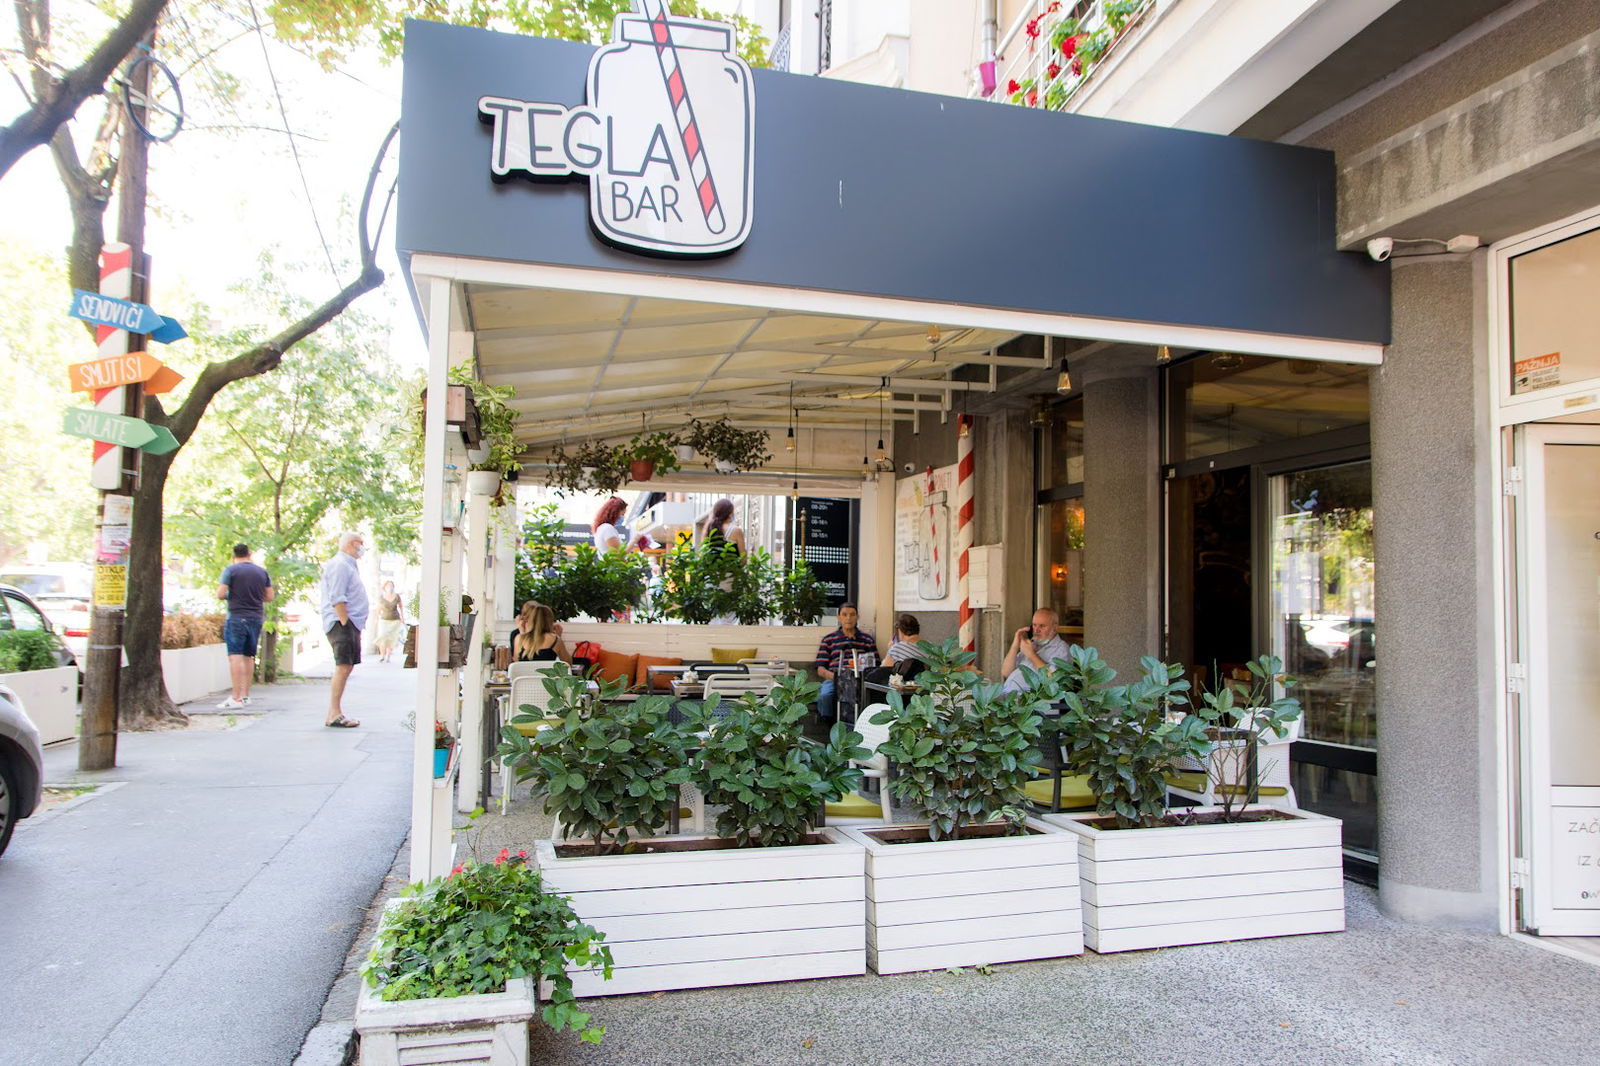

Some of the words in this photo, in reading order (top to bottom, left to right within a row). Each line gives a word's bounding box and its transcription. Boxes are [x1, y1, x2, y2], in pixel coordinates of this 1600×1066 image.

[485, 102, 680, 181] TEGLA
[611, 181, 683, 223] BAR
[78, 295, 144, 329] SENDVIČI
[79, 356, 142, 388] SMUTISI
[74, 412, 131, 443] SALATE
[1568, 817, 1600, 834] ZAČ
